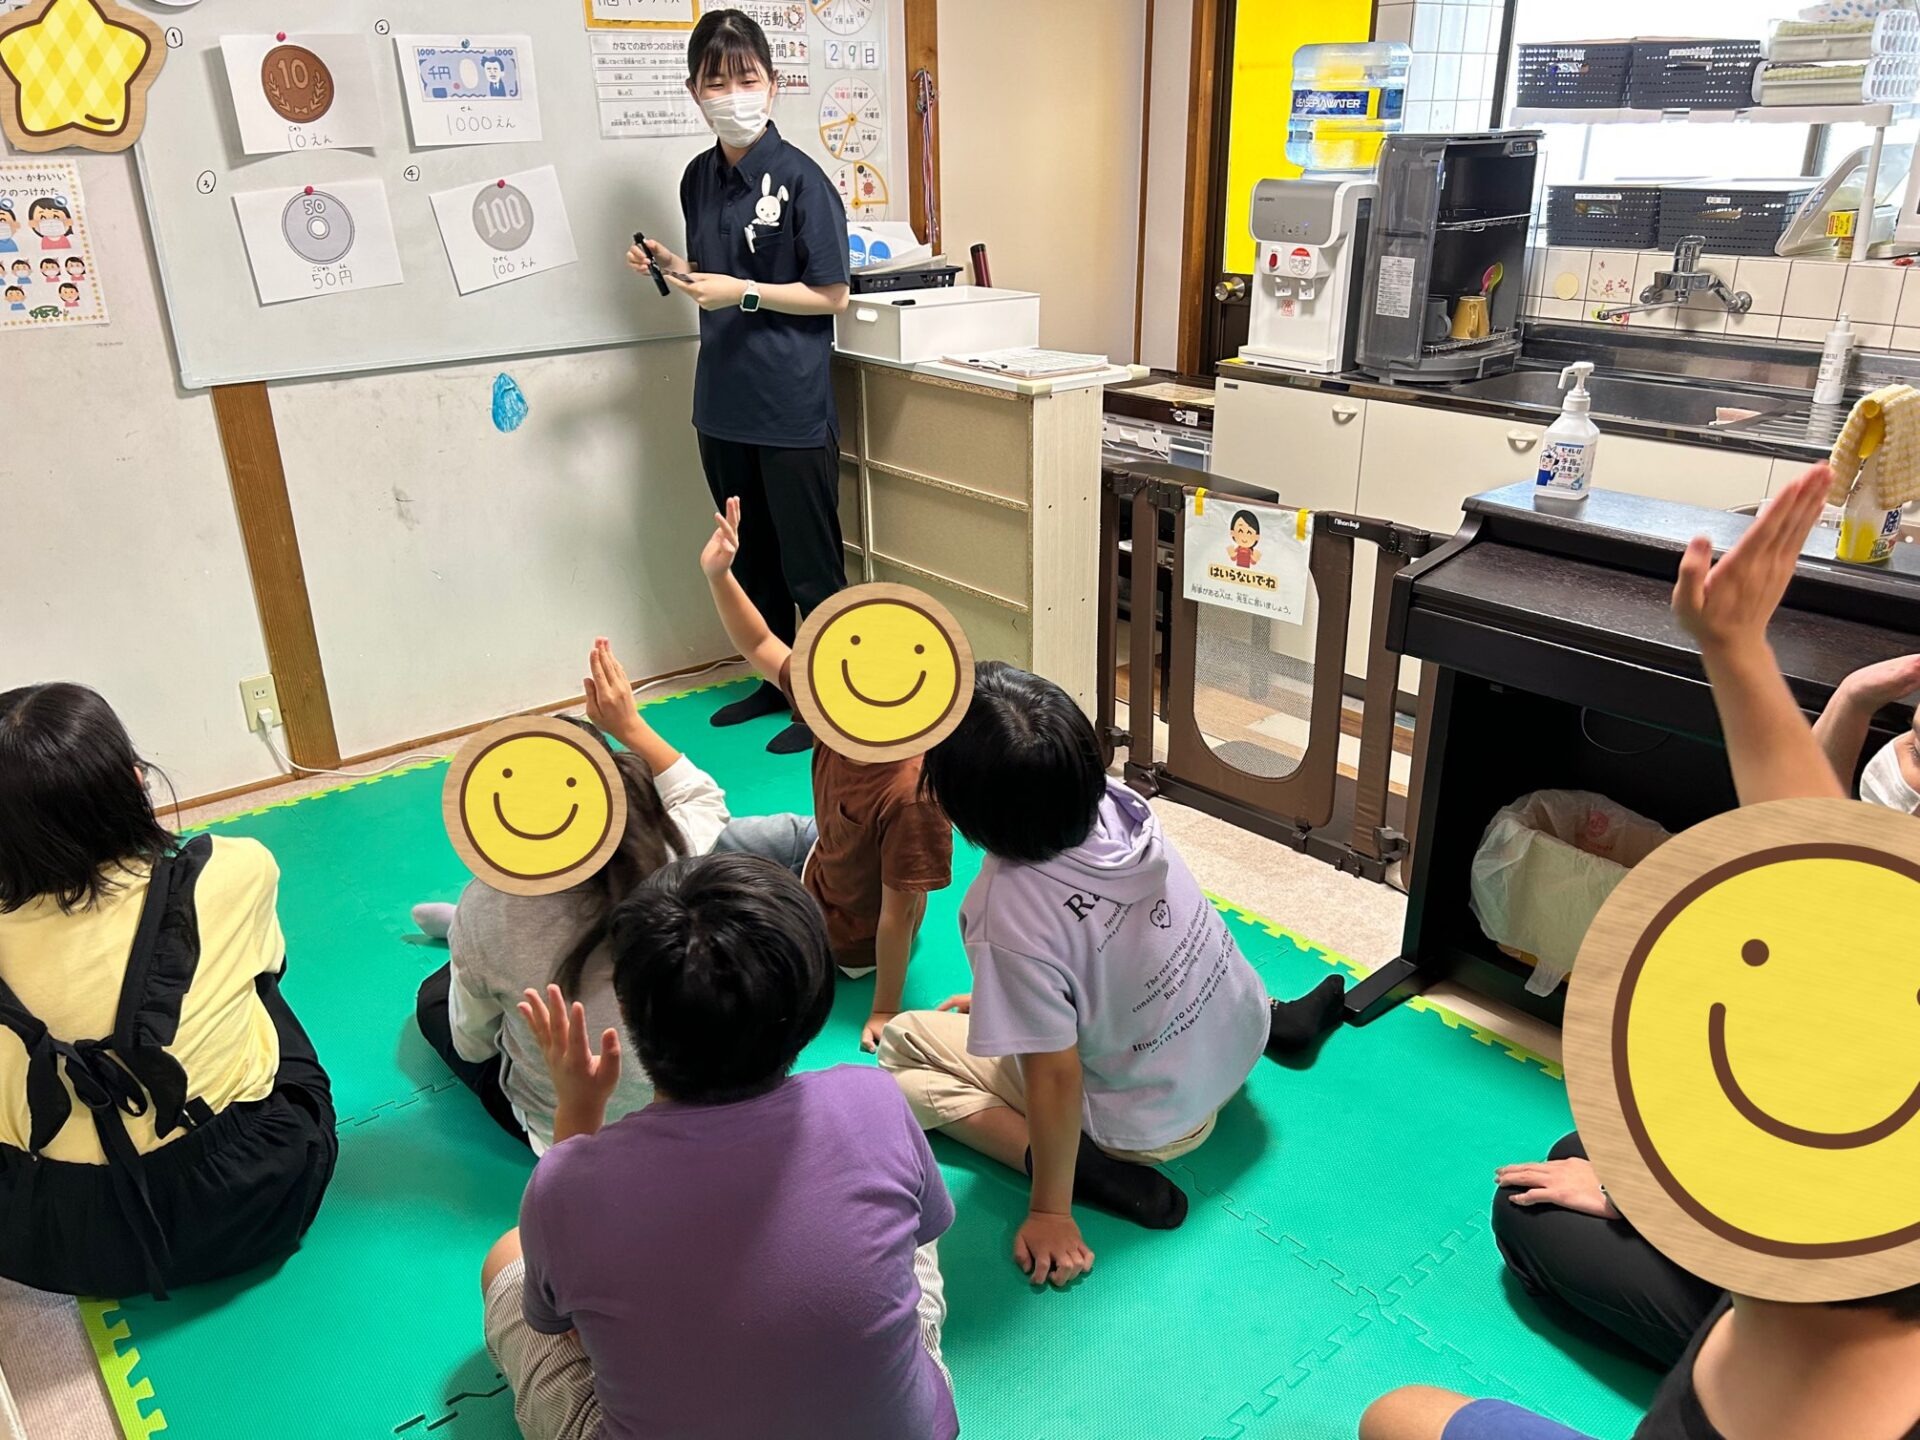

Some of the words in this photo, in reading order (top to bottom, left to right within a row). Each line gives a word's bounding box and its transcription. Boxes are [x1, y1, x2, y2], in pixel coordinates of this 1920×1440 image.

[417, 48, 436, 56] 1000
[277, 58, 310, 89] 10
[428, 66, 451, 80] 千円
[303, 199, 327, 215] 50
[479, 194, 525, 238] 100
[311, 269, 353, 290] 50円
[1209, 567, 1277, 589] はいらないでね
[1144, 975, 1159, 990] The
[1159, 959, 1171, 977] real
[1170, 937, 1190, 962] voyage
[1132, 987, 1161, 1013] consists
[1161, 974, 1174, 992] not
[1171, 967, 1180, 978] in
[1163, 986, 1179, 1001] But
[1132, 1039, 1158, 1052] BEING
[1174, 1012, 1185, 1022] TO
[1185, 996, 1200, 1013] LIVE
